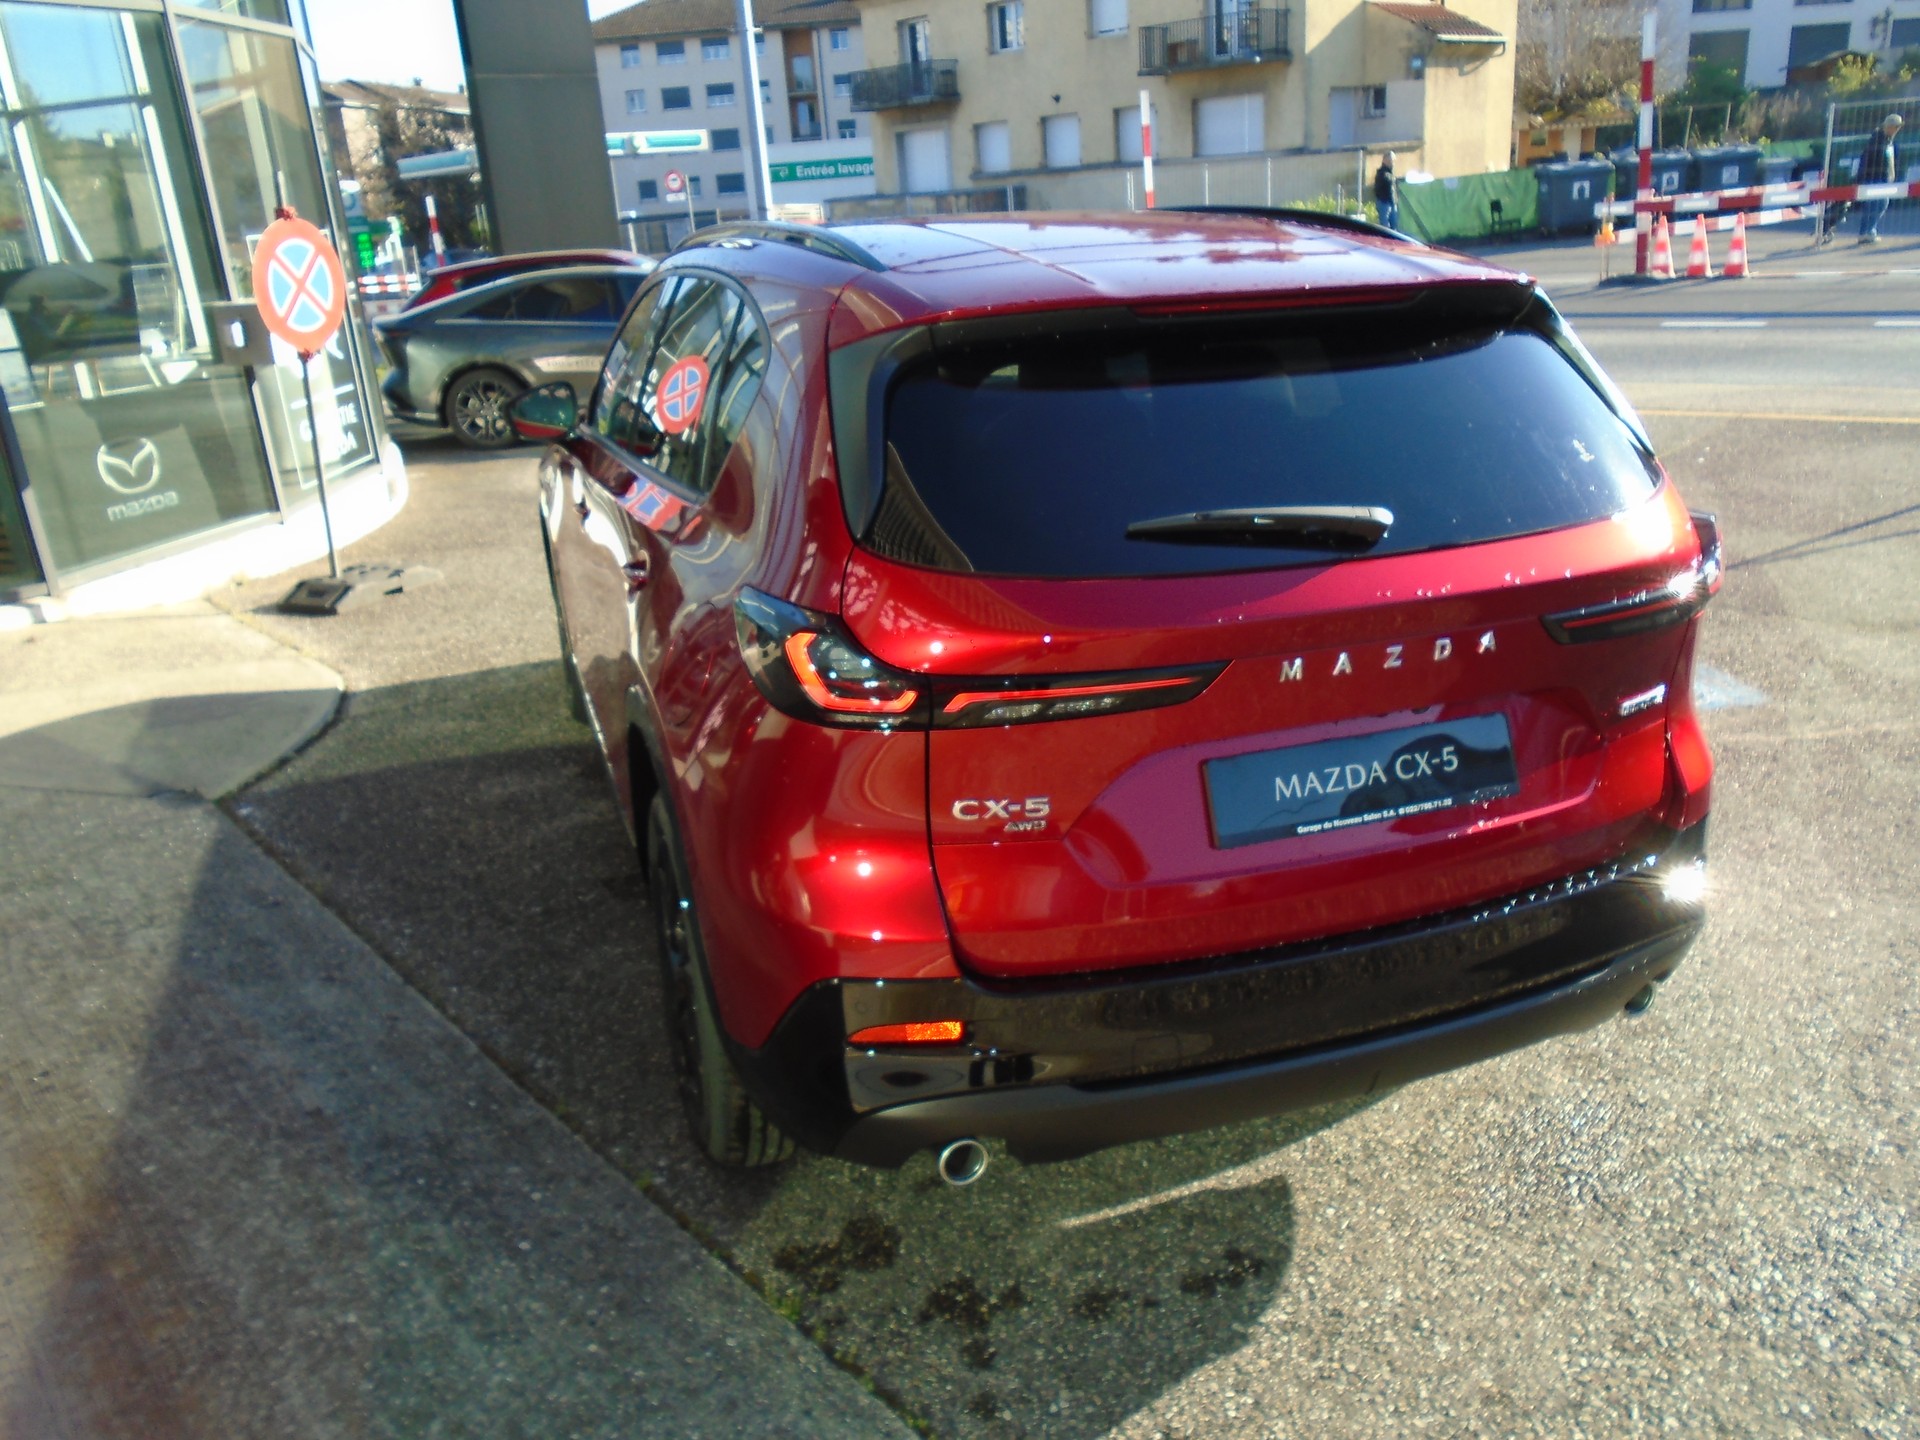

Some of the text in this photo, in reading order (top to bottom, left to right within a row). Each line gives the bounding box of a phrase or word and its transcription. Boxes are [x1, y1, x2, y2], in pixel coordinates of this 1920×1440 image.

[796, 164, 835, 178] Entrée
[107, 491, 179, 521] mazda
[1279, 630, 1496, 682] MAZDA
[1275, 746, 1459, 801] MAZDA CX-5
[952, 797, 1050, 820] CX-5
[1003, 820, 1047, 832] AWD
[1297, 824, 1322, 834] Garage
[1323, 821, 1333, 830] du
[1334, 818, 1363, 828] Nouveau
[1364, 812, 1382, 822] Salon
[1383, 810, 1396, 818] S.A.
